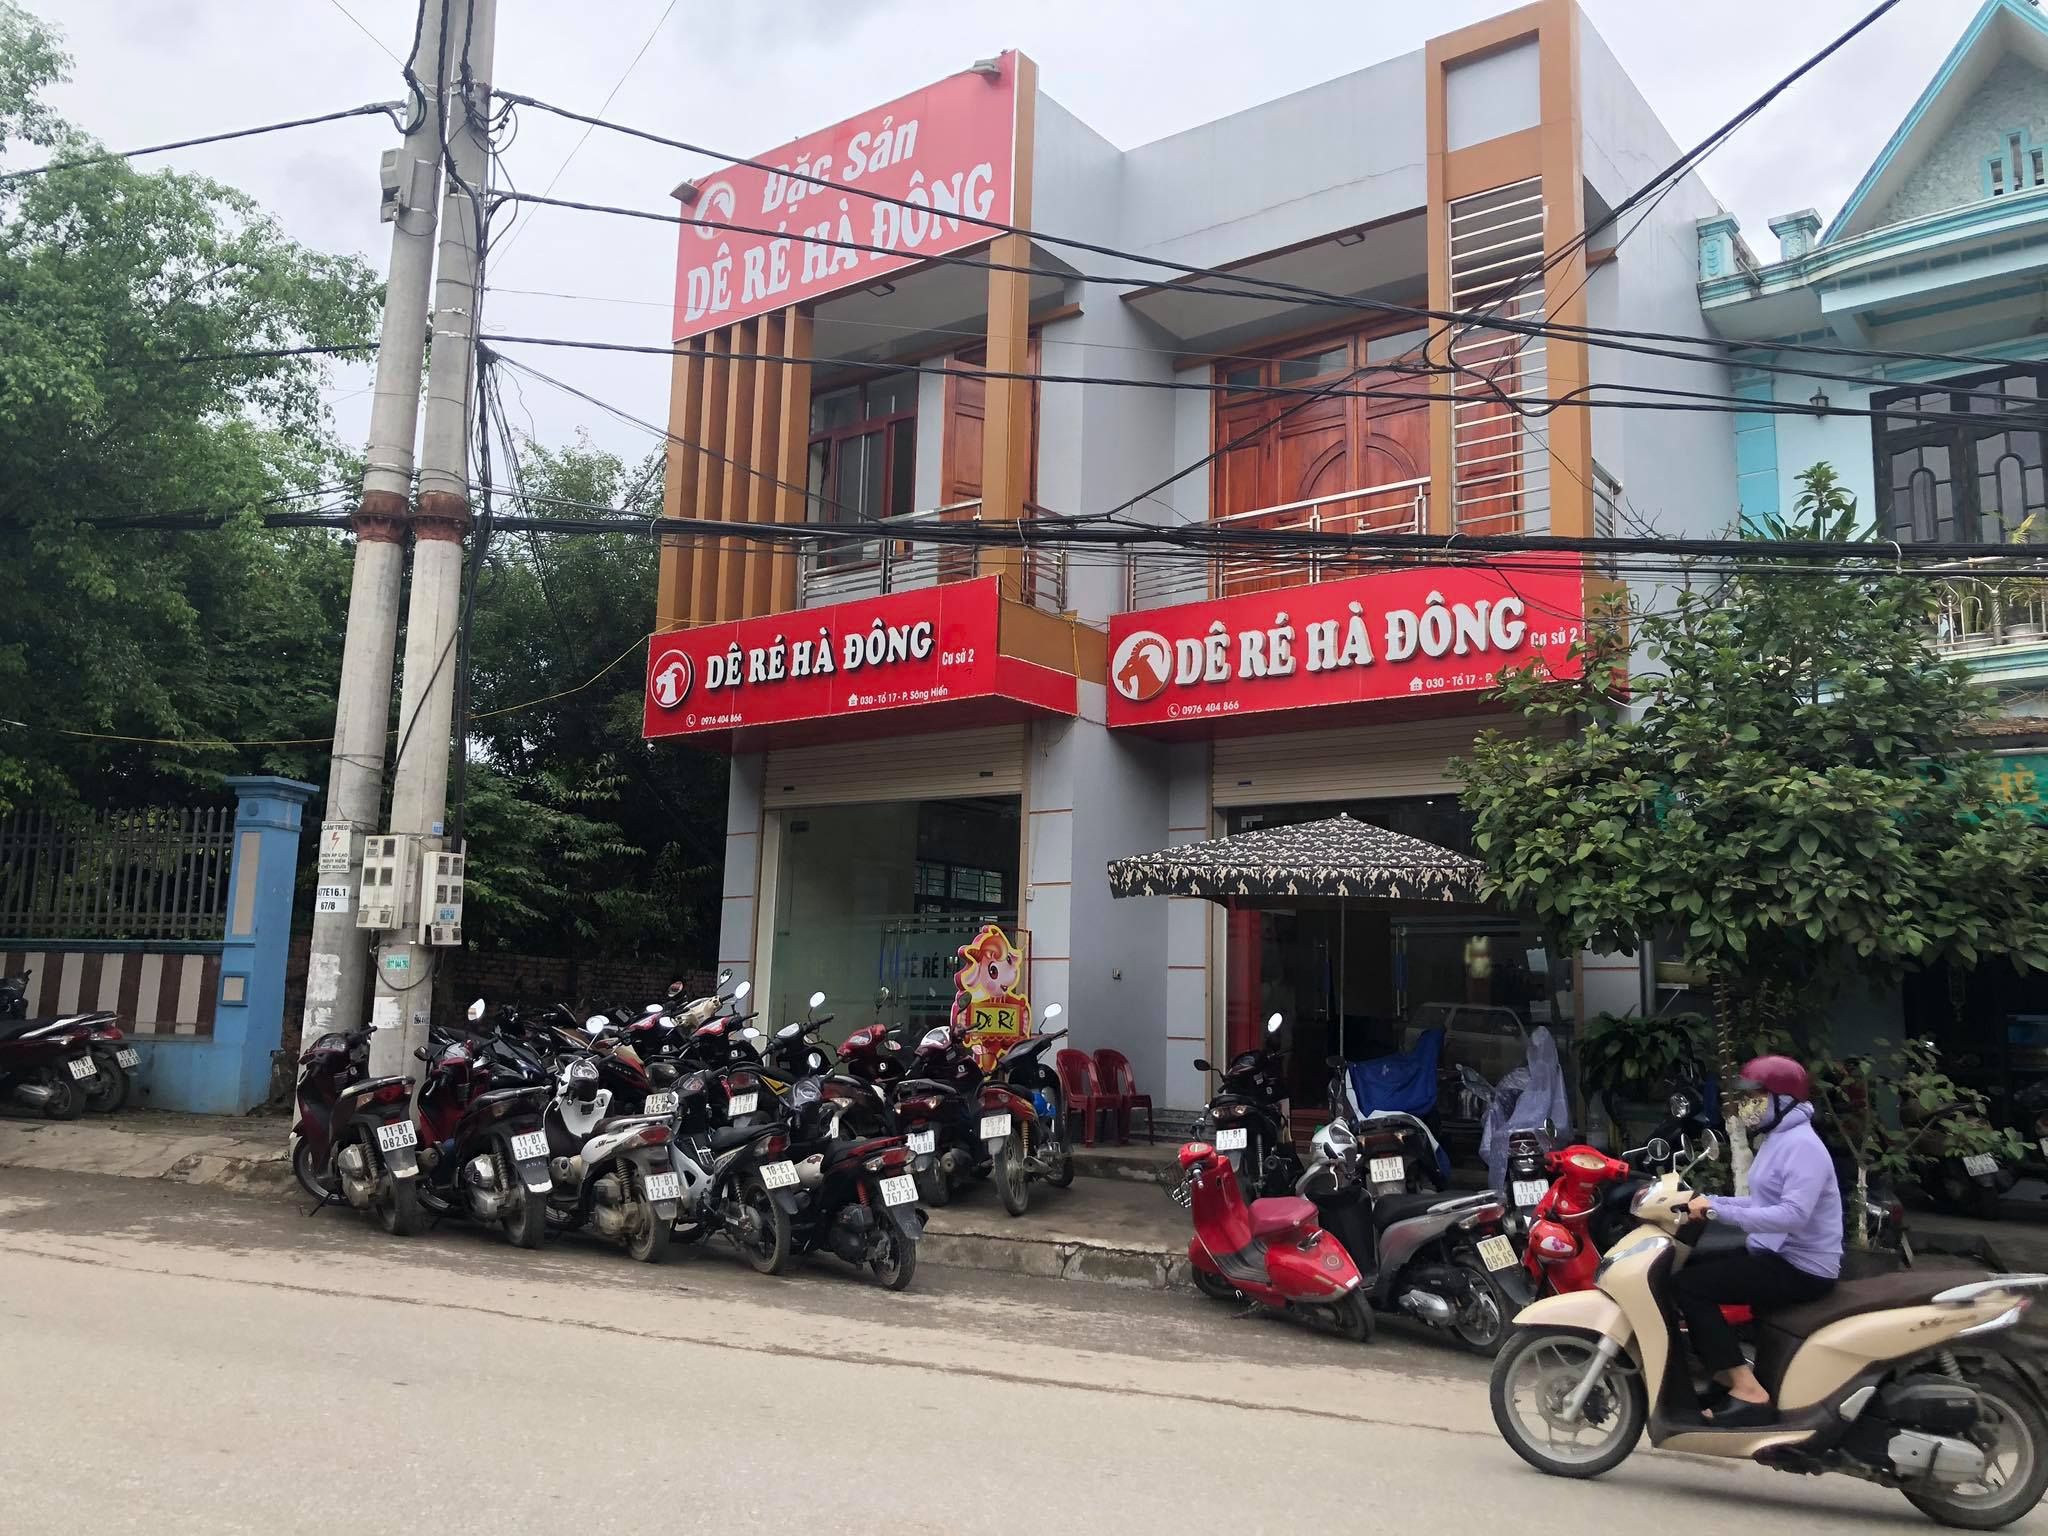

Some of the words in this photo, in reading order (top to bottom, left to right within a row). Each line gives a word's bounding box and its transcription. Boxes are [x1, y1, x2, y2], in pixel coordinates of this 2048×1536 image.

[762, 152, 833, 214] Đặc
[842, 115, 919, 183] Sản
[684, 243, 733, 323] DÊ
[741, 219, 792, 304] RÉ
[800, 198, 860, 284] HÀ
[870, 161, 995, 261] ĐÔNG
[1174, 621, 1232, 686] DÊ
[1238, 612, 1295, 678] RÉ
[1306, 601, 1375, 673] HÀ
[1385, 590, 1527, 664] ĐÔNG
[1551, 625, 1567, 647] sở
[1569, 627, 1579, 643] 2
[705, 642, 743, 690] DÊ
[748, 634, 785, 684] RÉ
[790, 628, 835, 677] HÀ
[844, 617, 934, 671] ĐÔNG
[942, 651, 954, 666] Cơ
[956, 647, 966, 664] sở
[968, 648, 975, 663] 2
[1426, 677, 1444, 689] 030
[1452, 672, 1464, 686] Tổ
[1466, 674, 1476, 685] 17
[1485, 672, 1494, 683] P.
[860, 695, 874, 706] 030
[878, 692, 887, 704] Tổ
[888, 693, 897, 703] 17
[910, 689, 929, 701] Sông
[931, 685, 948, 697] Hiến
[1182, 704, 1203, 715] 0976
[1205, 702, 1221, 713] 404
[1223, 700, 1240, 711] 866
[701, 715, 717, 726] 0976
[717, 714, 729, 724] 404
[382, 1133, 415, 1150] 082.66
[516, 1143, 548, 1159] 334.56
[650, 1185, 680, 1201] 124.83
[886, 1188, 916, 1205] 767.37
